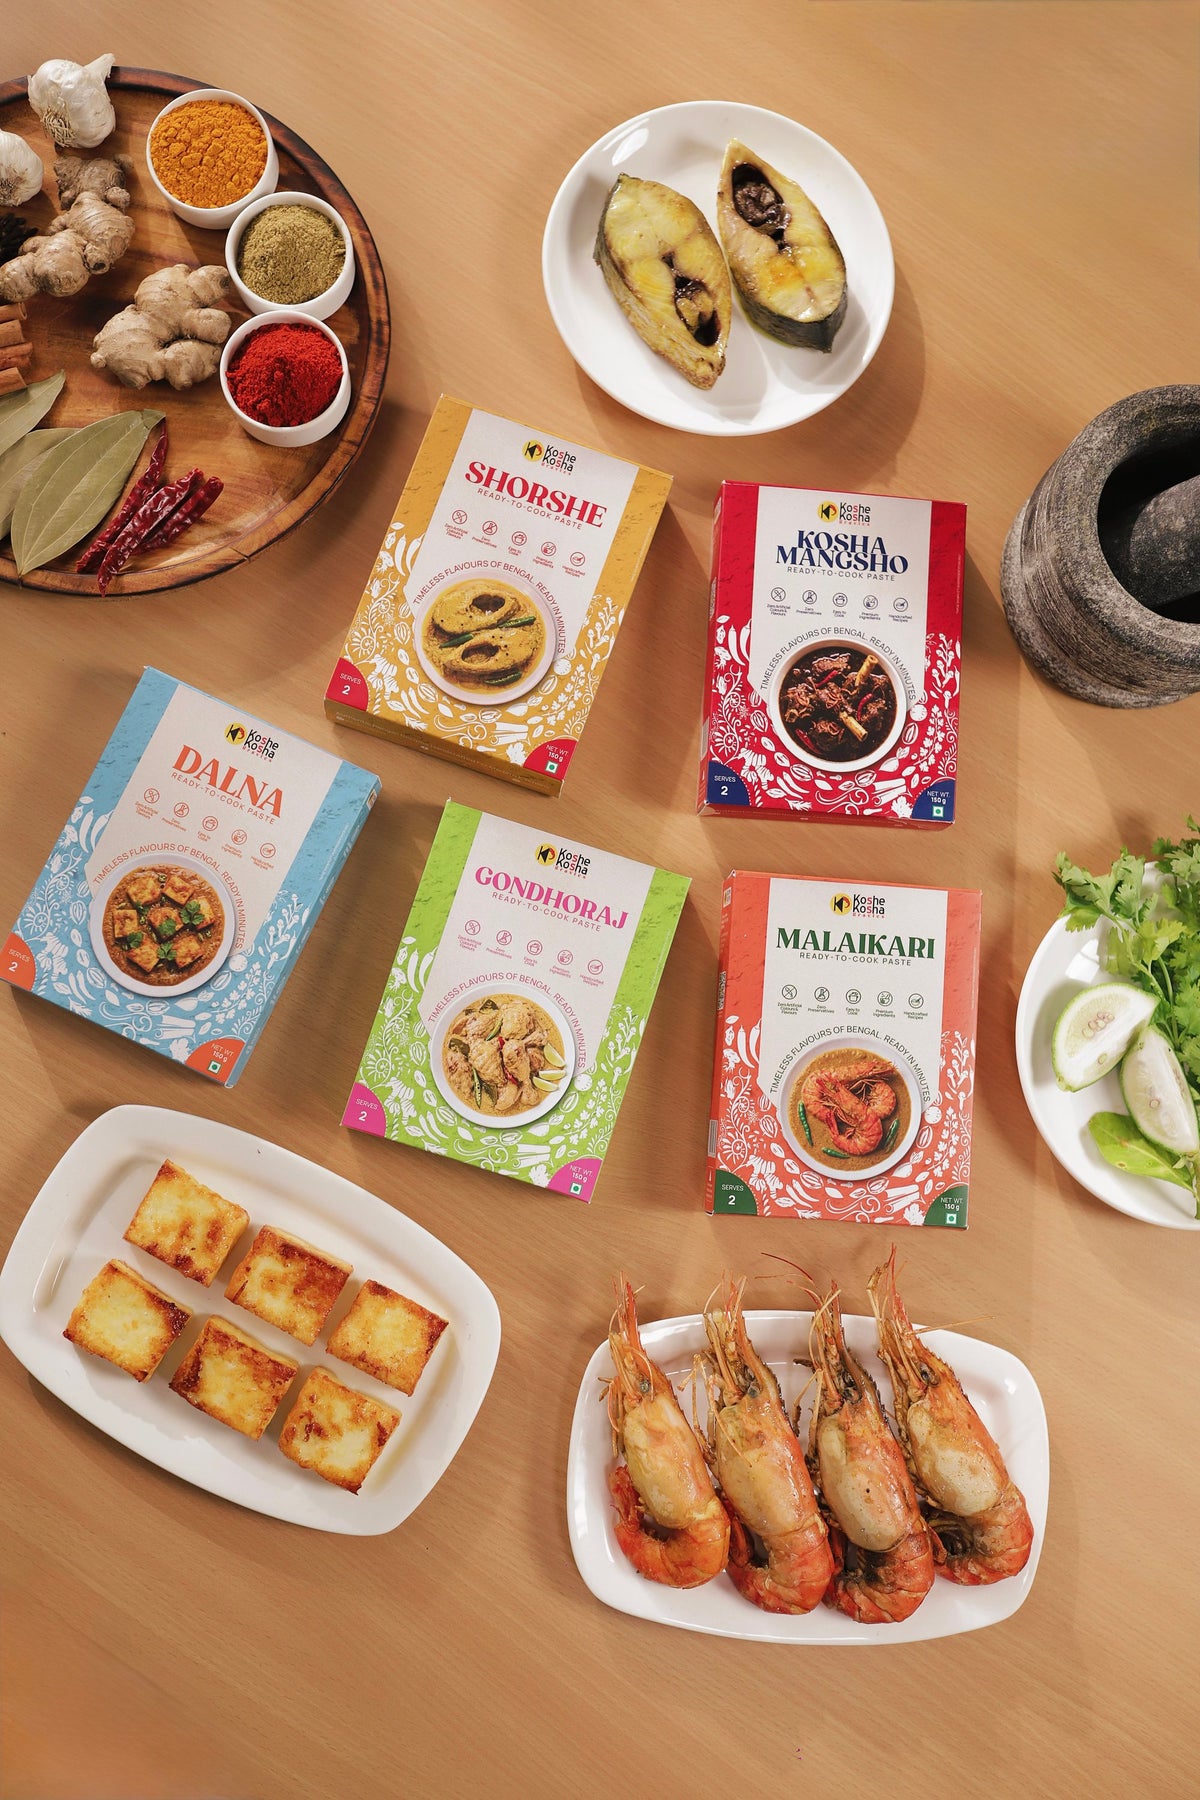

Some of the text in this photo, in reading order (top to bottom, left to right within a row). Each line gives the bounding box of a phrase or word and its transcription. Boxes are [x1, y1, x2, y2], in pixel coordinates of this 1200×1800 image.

[542, 454, 573, 472] Kosha
[544, 445, 576, 463] Koshe
[465, 461, 607, 528] SHORSHE
[477, 488, 582, 530] READY-TO-COOK PASTE
[839, 511, 870, 522] Kosha
[840, 502, 871, 515] Koshe
[798, 530, 888, 556] KOSHA
[776, 545, 908, 574] MANGSHO
[787, 566, 895, 581] READY-TO-COOK PASTE
[413, 573, 445, 604] TIMELESS
[444, 560, 489, 576] FLAVOURS
[536, 582, 557, 605] READY
[552, 606, 561, 615] IN
[760, 653, 783, 689] TIMELESS
[780, 629, 820, 655] FLAVOURS
[869, 636, 894, 656] READY
[892, 655, 901, 665] IN
[339, 673, 361, 684] SERVES
[342, 685, 350, 695] 2
[244, 738, 275, 759] Kosha
[247, 729, 279, 750] Koshe
[172, 745, 283, 818] DALNA
[721, 786, 728, 795] 2
[171, 772, 275, 824] READY-TO-COOK PASTE
[556, 857, 588, 875] Kosha
[558, 848, 591, 866] Koshe
[93, 852, 129, 884] TIMELESS
[129, 843, 176, 857] FLAVOURS
[177, 844, 190, 853] OF
[221, 871, 241, 896] READY
[235, 898, 244, 908] IN
[475, 866, 628, 929] GONDHORAJ
[853, 894, 885, 907] Koshe
[492, 892, 601, 932] READY-TO-COOK PASTE
[853, 903, 885, 914] Kosha
[776, 928, 935, 959] MALAIKARI
[8, 949, 31, 962] SERVES
[800, 952, 911, 966] READY-TO-COOK PASTE
[9, 962, 18, 972] 2
[428, 988, 460, 1022] TIMELESS
[459, 972, 504, 991] FLAVOURS
[553, 993, 576, 1017] READY
[571, 1018, 580, 1028] IN
[211, 1043, 223, 1053] NET
[213, 1051, 224, 1059] 150
[770, 1054, 793, 1093] TIMELESS
[791, 1028, 832, 1056] FLAVOURS
[833, 1026, 844, 1034] OF
[883, 1035, 909, 1055] READY
[906, 1054, 916, 1064] IN
[356, 1099, 378, 1110] SERVES
[359, 1111, 367, 1121] 2
[570, 1165, 582, 1173] NET
[728, 1195, 735, 1205] 2
